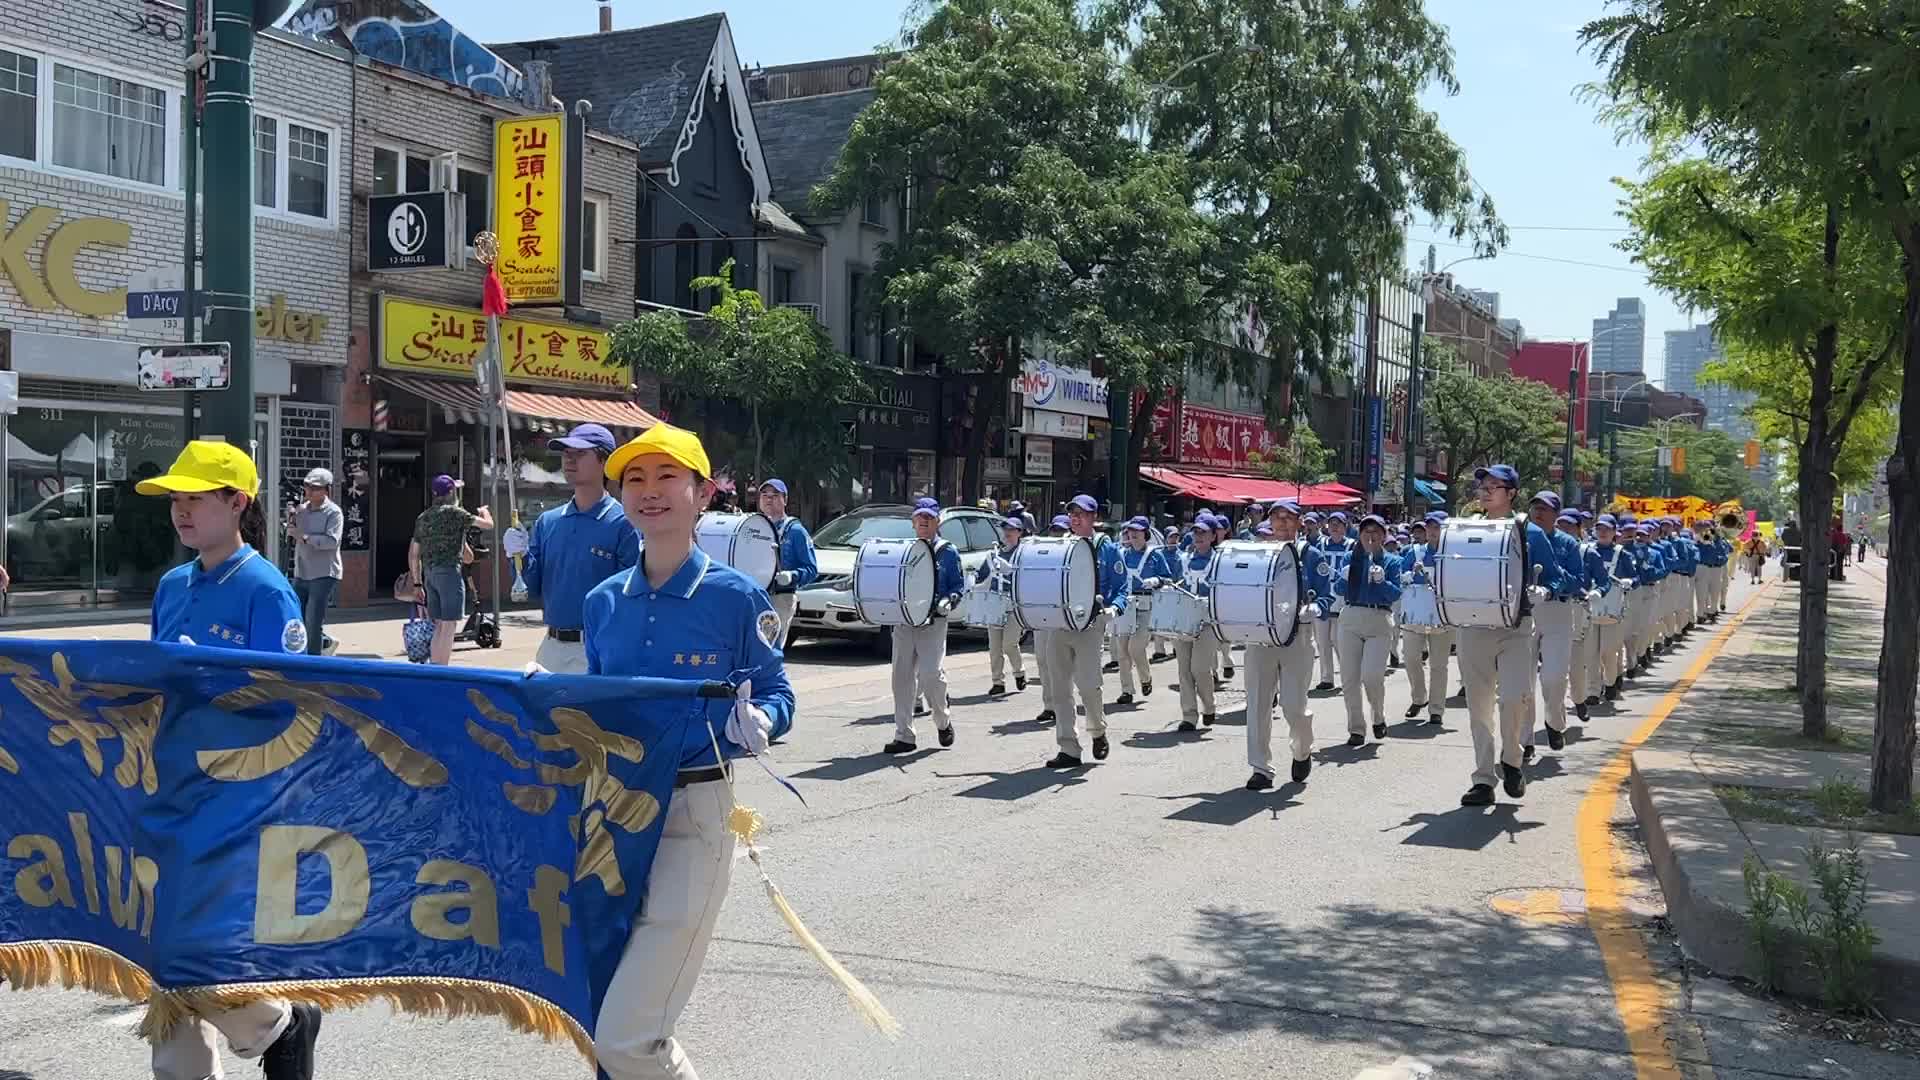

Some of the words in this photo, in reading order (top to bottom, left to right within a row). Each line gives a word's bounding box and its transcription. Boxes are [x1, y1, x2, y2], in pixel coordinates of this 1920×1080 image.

[512, 127, 547, 258] 汕頭小食家
[400, 255, 426, 264] SMILES
[142, 293, 179, 314] D'Arcy
[162, 318, 178, 328] 133
[510, 352, 620, 386] Restaurant
[40, 408, 64, 421] 311
